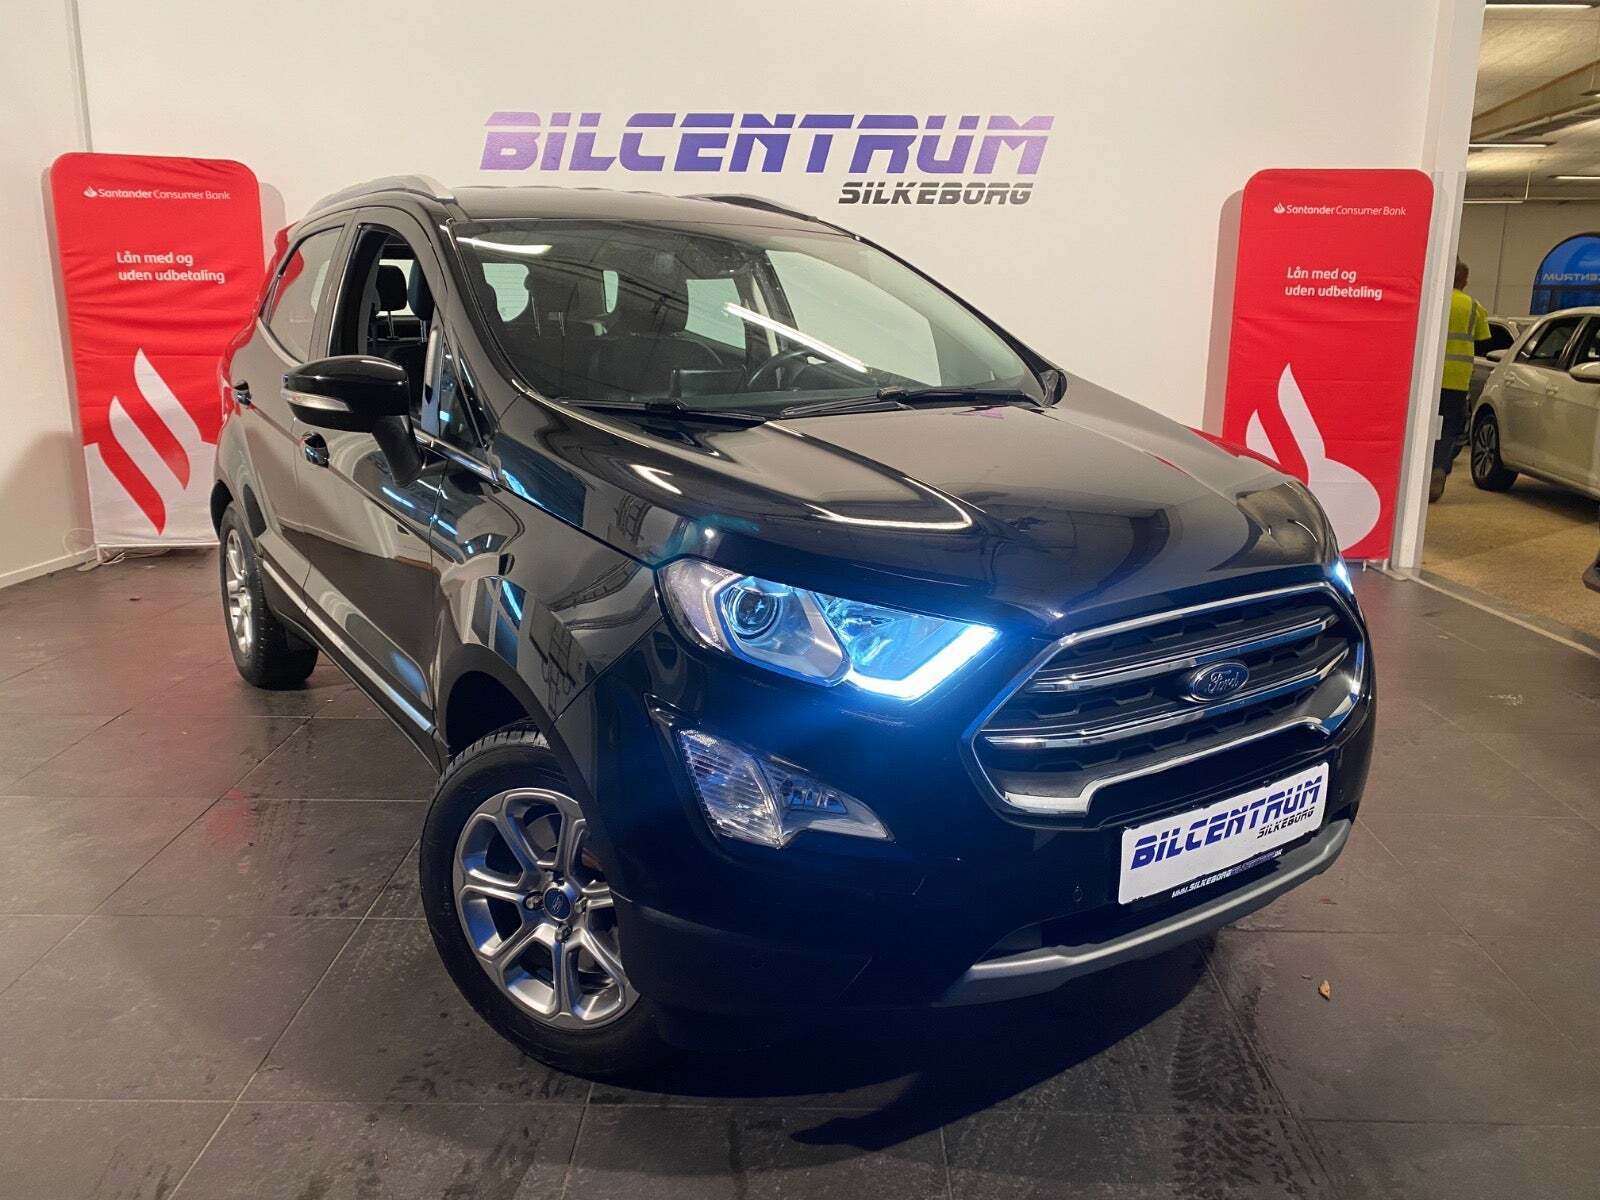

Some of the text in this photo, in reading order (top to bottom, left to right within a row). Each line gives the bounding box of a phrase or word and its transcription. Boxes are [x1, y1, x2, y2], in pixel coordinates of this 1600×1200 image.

[479, 112, 1055, 174] BILCENTRUM
[98, 188, 231, 200] Santander Consumer Bank
[837, 181, 1034, 205] SILKEBORG
[1286, 204, 1406, 216] Santander Consumer Bank
[116, 250, 193, 267] Lån med og
[118, 269, 225, 284] uden udbetaling
[1287, 266, 1357, 283] Lån med og
[1285, 284, 1383, 301] uden udbetaling
[1207, 669, 1239, 695] Ford
[1130, 775, 1322, 870] BILCENTRUM
[1257, 806, 1315, 839] SILKEBORG
